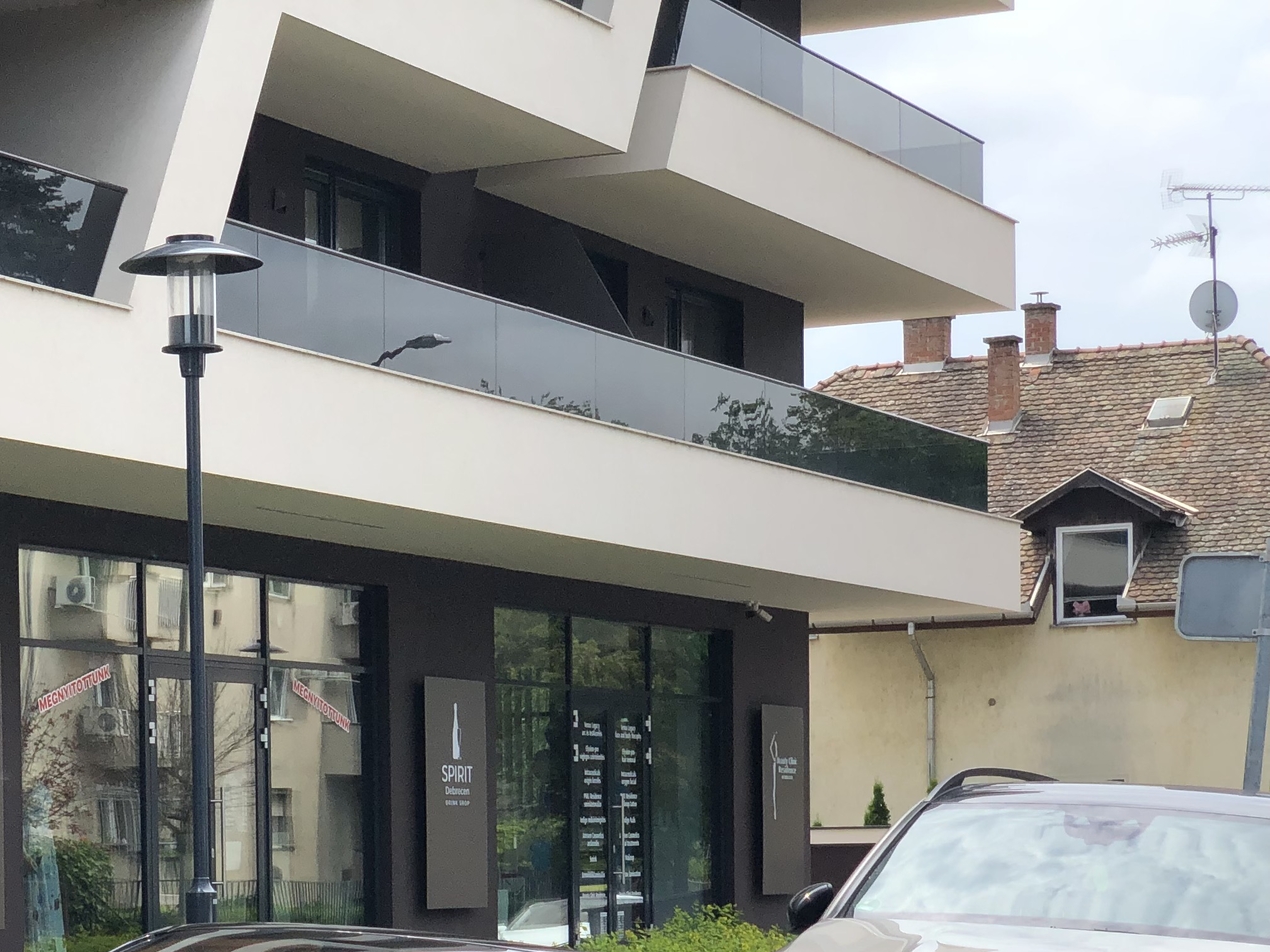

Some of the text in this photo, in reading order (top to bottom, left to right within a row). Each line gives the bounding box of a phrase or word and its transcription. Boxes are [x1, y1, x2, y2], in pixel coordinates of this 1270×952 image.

[37, 664, 111, 713] MEGNYITOTTUNK
[293, 679, 350, 732] MEGNYITOTTUNK
[441, 764, 473, 783] SPIRIT
[445, 785, 470, 796] Debrecen
